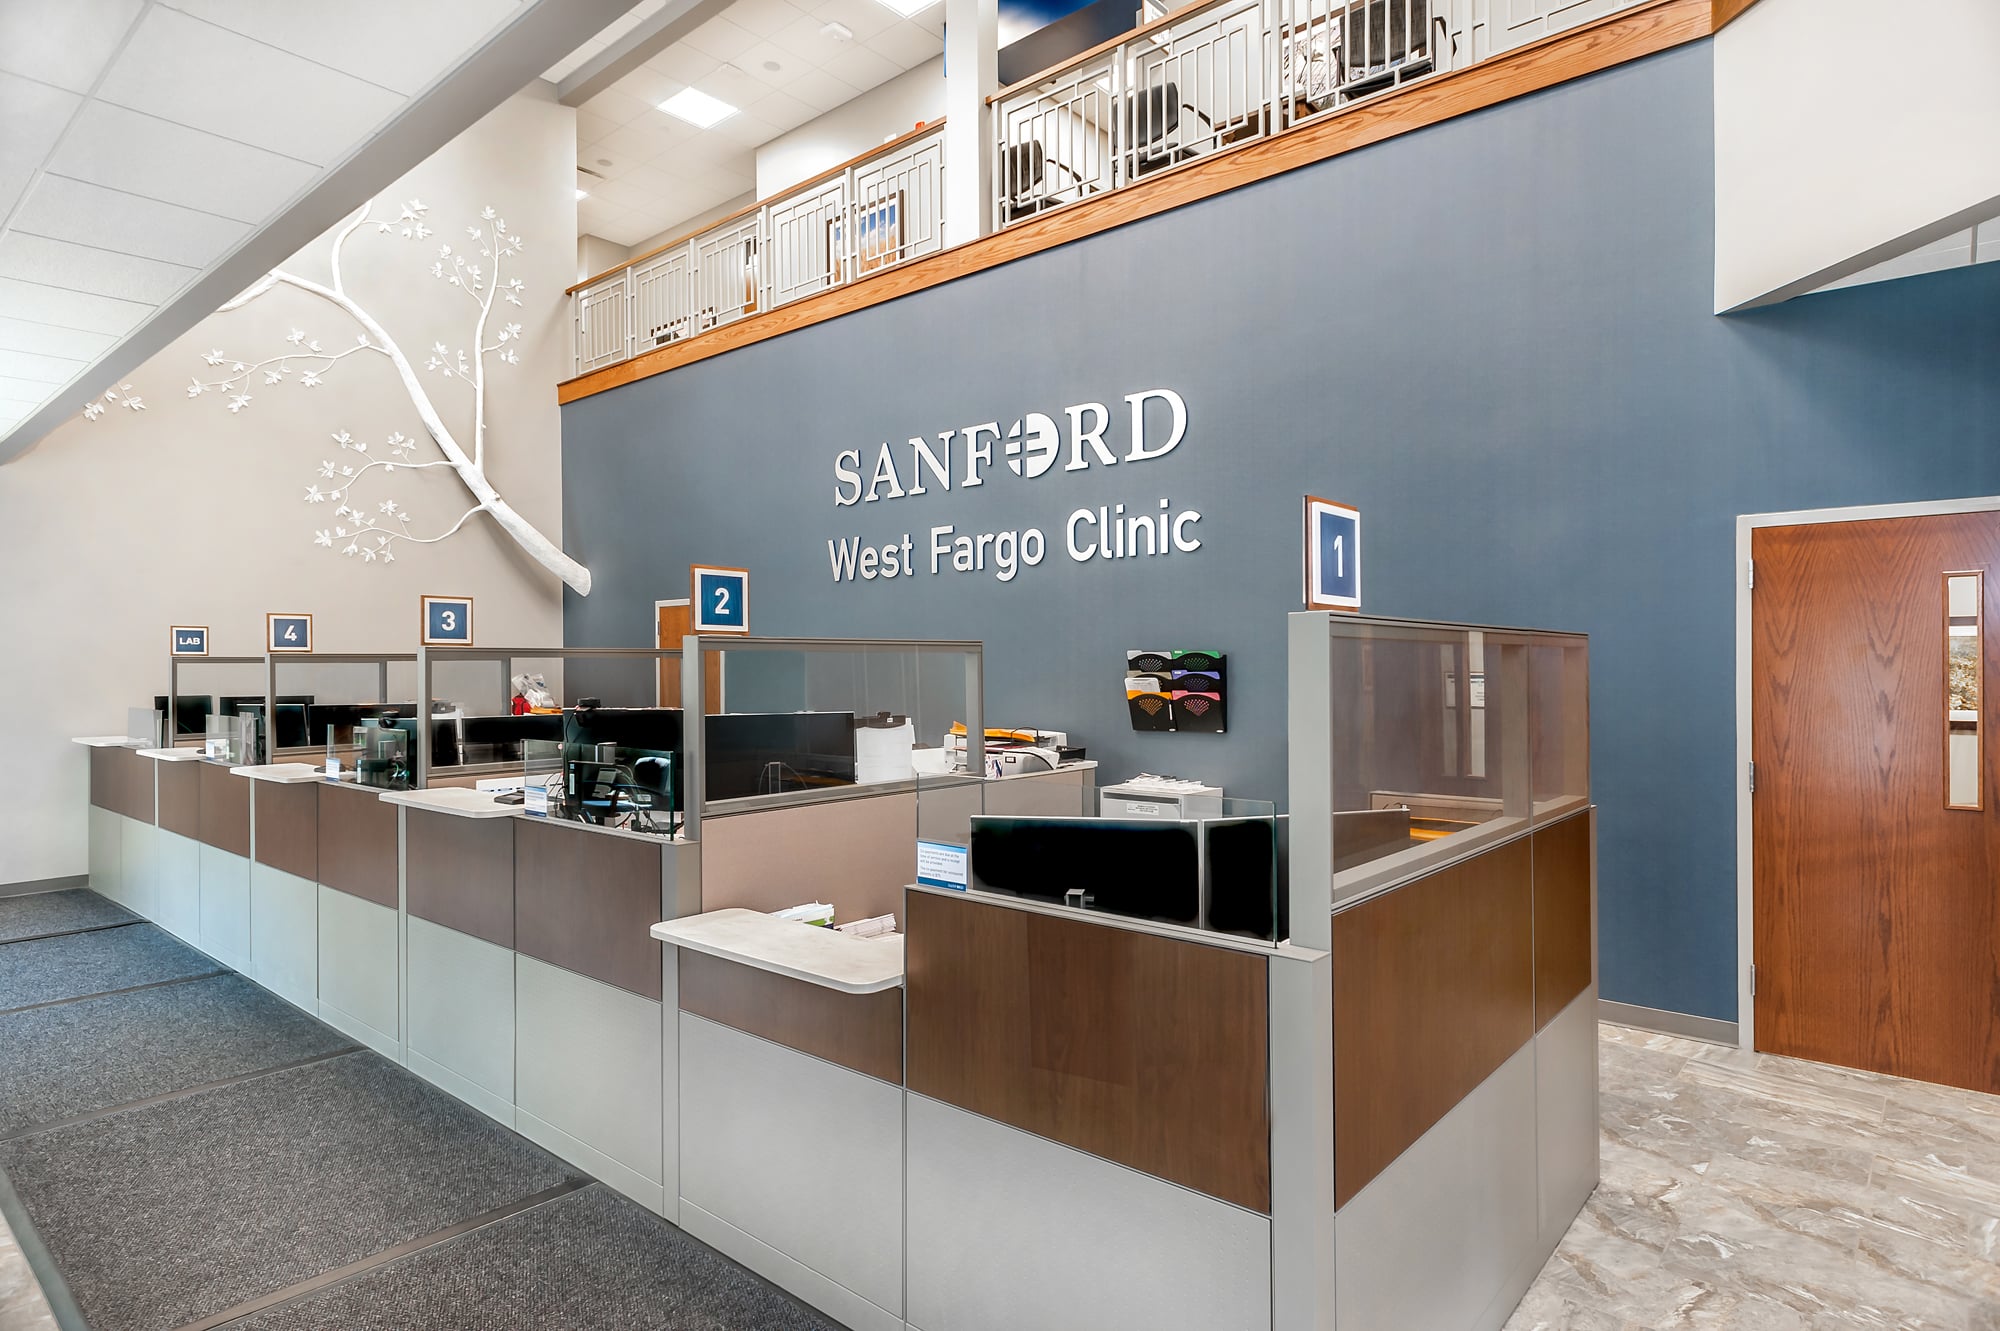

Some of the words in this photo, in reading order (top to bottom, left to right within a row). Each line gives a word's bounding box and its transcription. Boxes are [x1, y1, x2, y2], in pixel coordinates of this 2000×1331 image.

[834, 388, 1188, 507] SANFORD
[827, 533, 914, 582] West
[930, 525, 1046, 582] Fargo
[1066, 498, 1202, 562] Clinic
[1333, 535, 1343, 578] 1
[714, 587, 730, 615] 2
[283, 624, 298, 642] 4
[441, 610, 456, 631] 3
[179, 636, 201, 645] LAB
